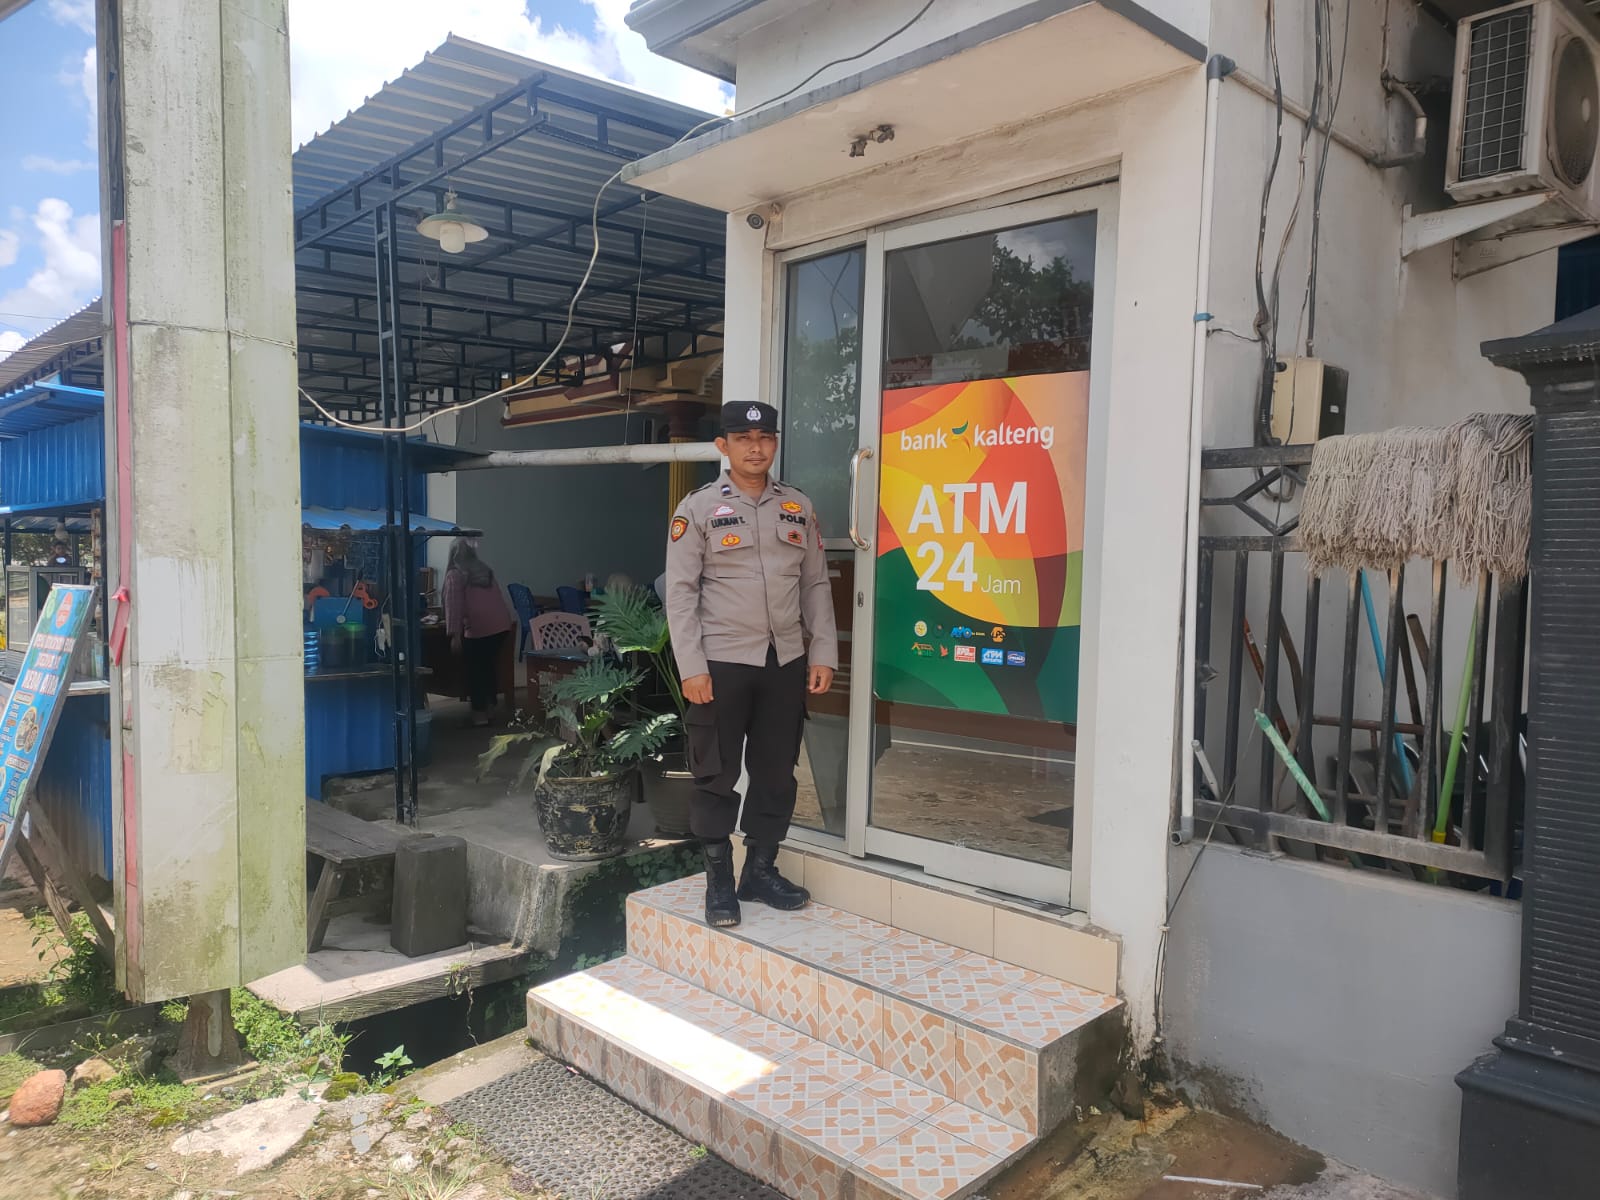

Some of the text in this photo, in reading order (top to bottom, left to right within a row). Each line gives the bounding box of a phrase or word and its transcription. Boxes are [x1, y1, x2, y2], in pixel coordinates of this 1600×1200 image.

[901, 422, 1055, 452] bank kalteng
[908, 481, 1028, 534] ATM
[916, 540, 1021, 594] 24 Jam
